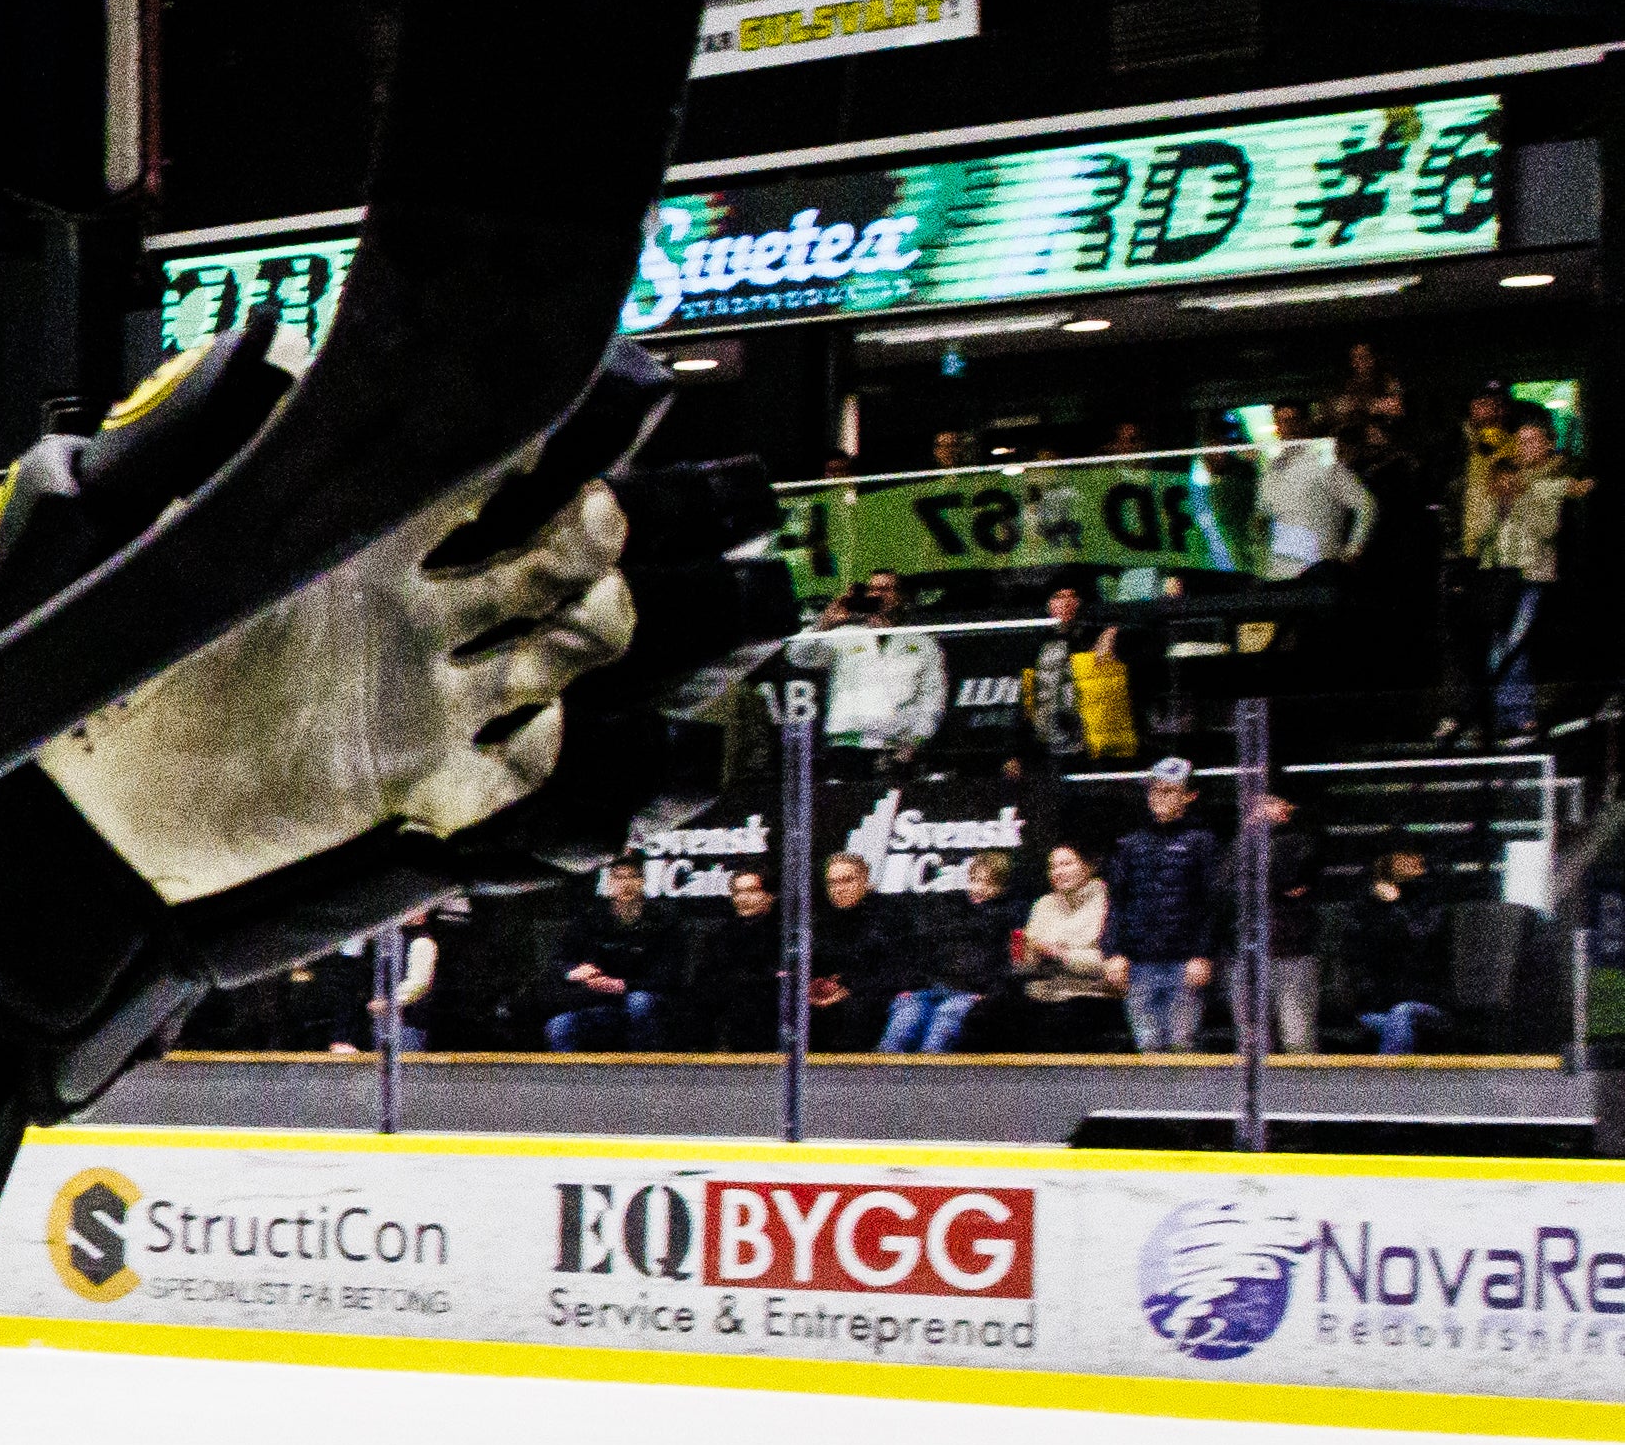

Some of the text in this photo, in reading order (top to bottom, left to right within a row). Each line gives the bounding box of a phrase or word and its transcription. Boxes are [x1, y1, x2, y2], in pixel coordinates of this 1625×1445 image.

[144, 1200, 449, 1265] StructiCon
[548, 1287, 1035, 1355] Service & Entreprenad
